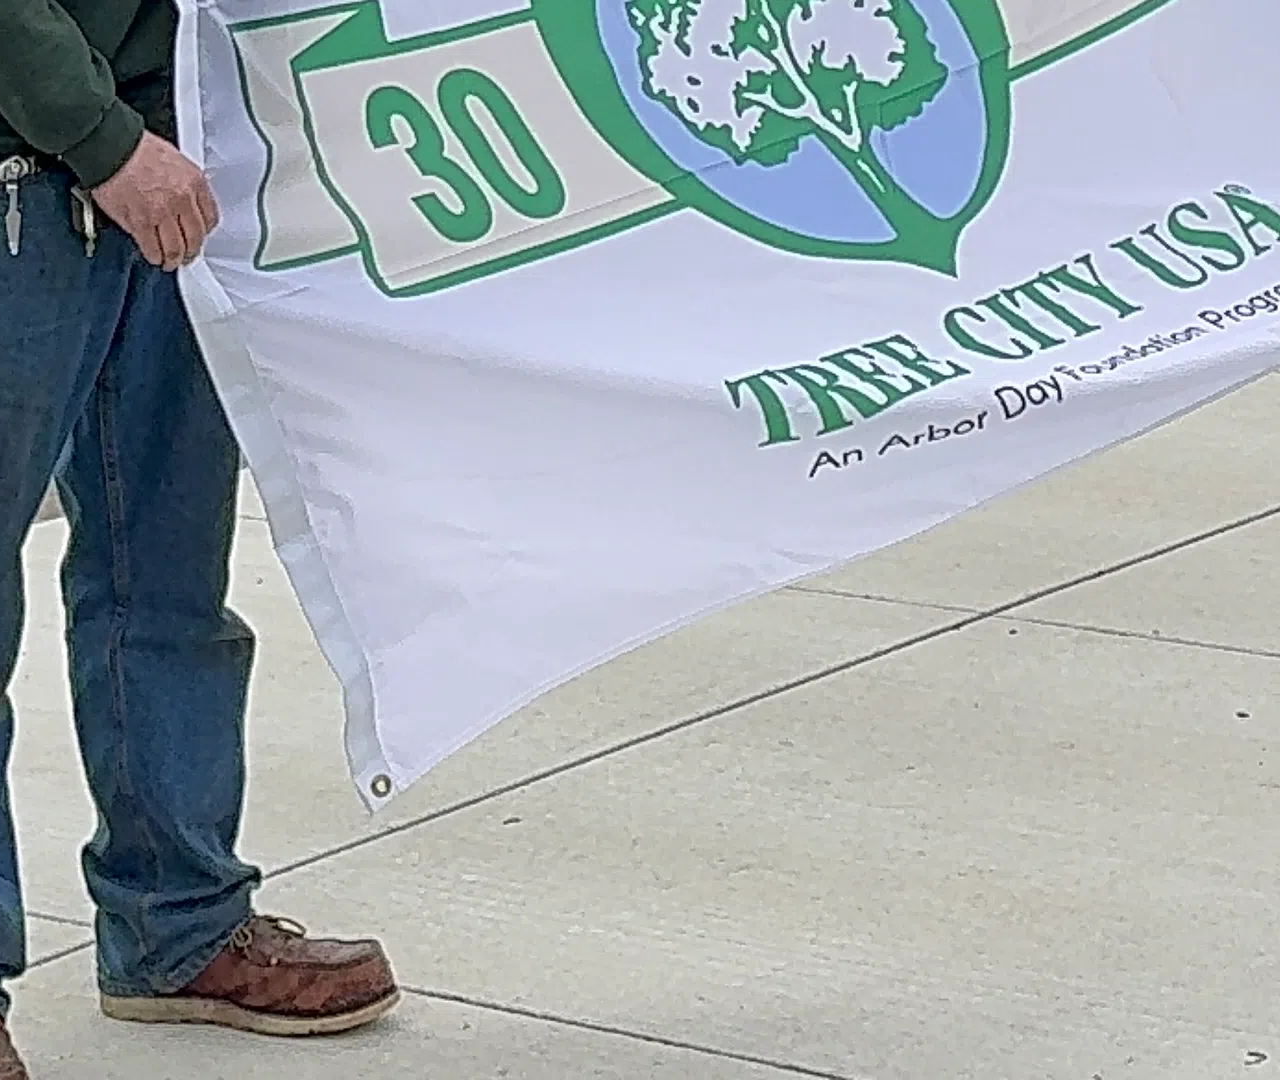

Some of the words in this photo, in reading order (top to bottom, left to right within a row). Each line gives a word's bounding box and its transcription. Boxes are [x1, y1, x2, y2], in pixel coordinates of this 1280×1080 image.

[365, 67, 566, 243] 30
[724, 334, 972, 447] TREE
[943, 253, 1145, 360] CITY
[808, 449, 864, 478] An
[877, 411, 988, 455] Arbor
[994, 374, 1063, 420] Day
[1053, 325, 1211, 380] Foundation
